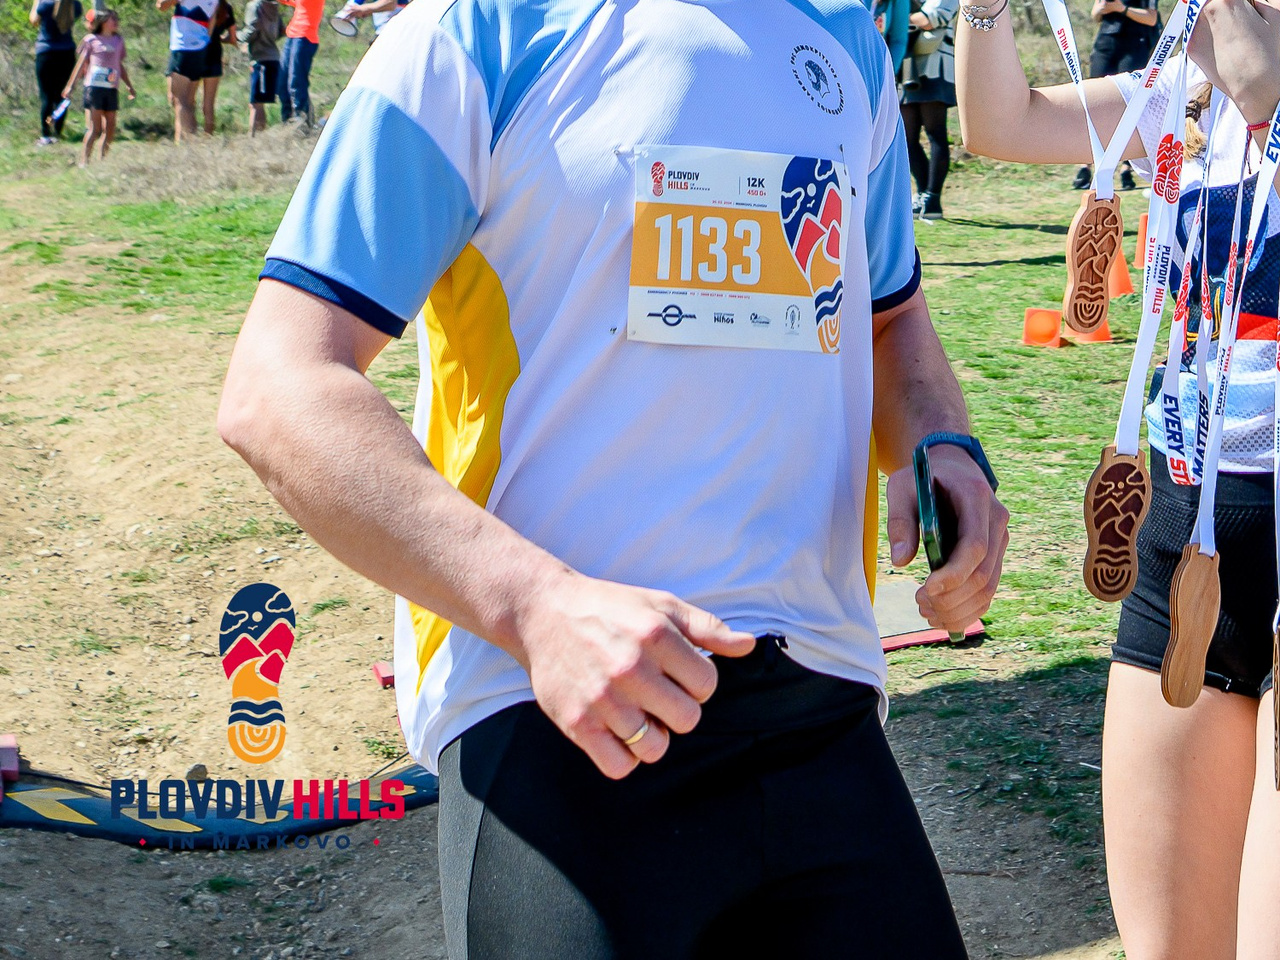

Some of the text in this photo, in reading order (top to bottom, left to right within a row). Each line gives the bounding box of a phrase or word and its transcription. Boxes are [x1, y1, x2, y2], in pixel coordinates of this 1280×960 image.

[1057, 27, 1069, 51] HILLS
[1155, 35, 1177, 67] PLOVDIV
[1144, 67, 1161, 89] HILLS
[667, 170, 766, 189] PLOVDIV 12K
[667, 180, 689, 191] HILLS
[655, 213, 762, 286] 1133
[1151, 244, 1172, 315] PLOVDIV HILLS
[1215, 374, 1227, 416] PLOVDIV
[1163, 392, 1186, 458] EVERY
[1191, 389, 1210, 479] MATTERS
